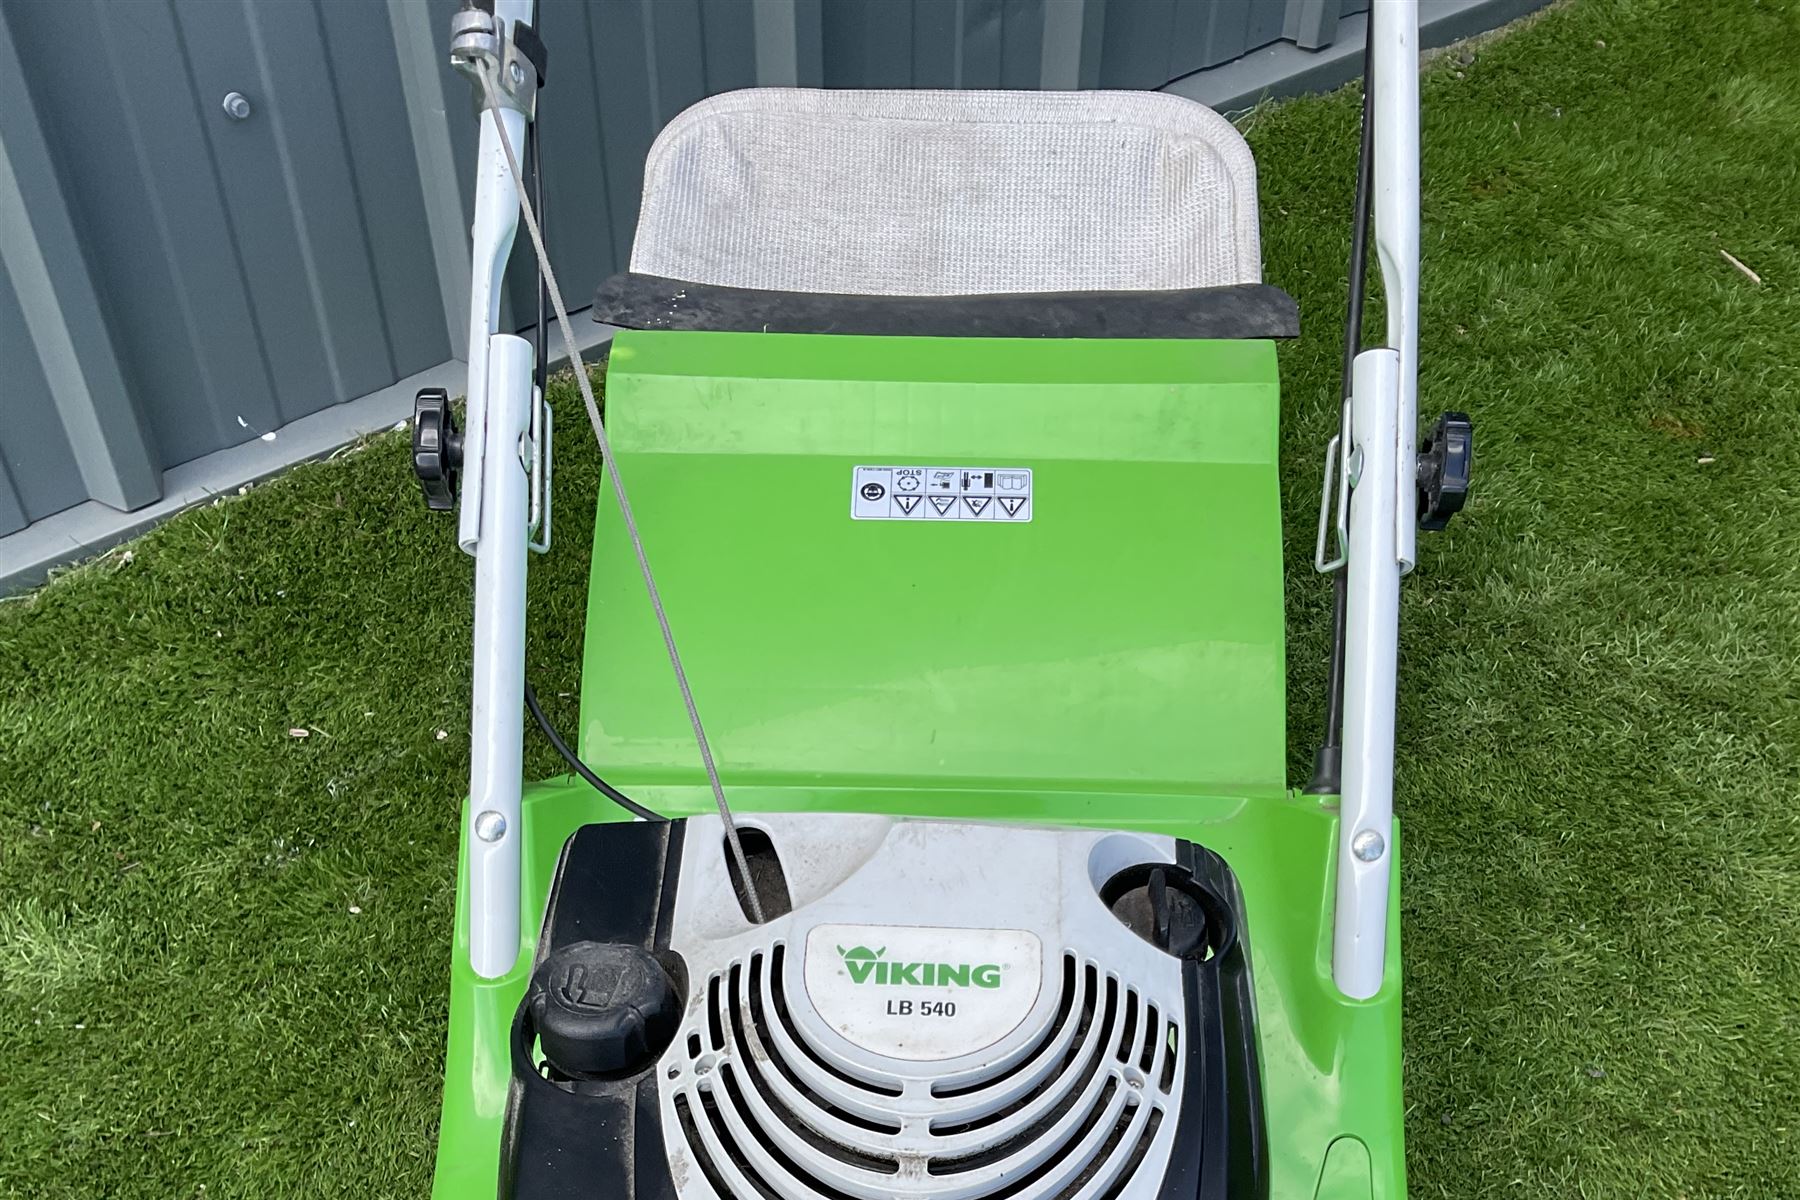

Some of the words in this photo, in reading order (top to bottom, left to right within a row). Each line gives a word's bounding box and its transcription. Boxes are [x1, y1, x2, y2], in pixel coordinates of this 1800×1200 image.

[844, 960, 1001, 989] VIKING
[887, 1000, 913, 1015] LB
[920, 1001, 956, 1017] 540
